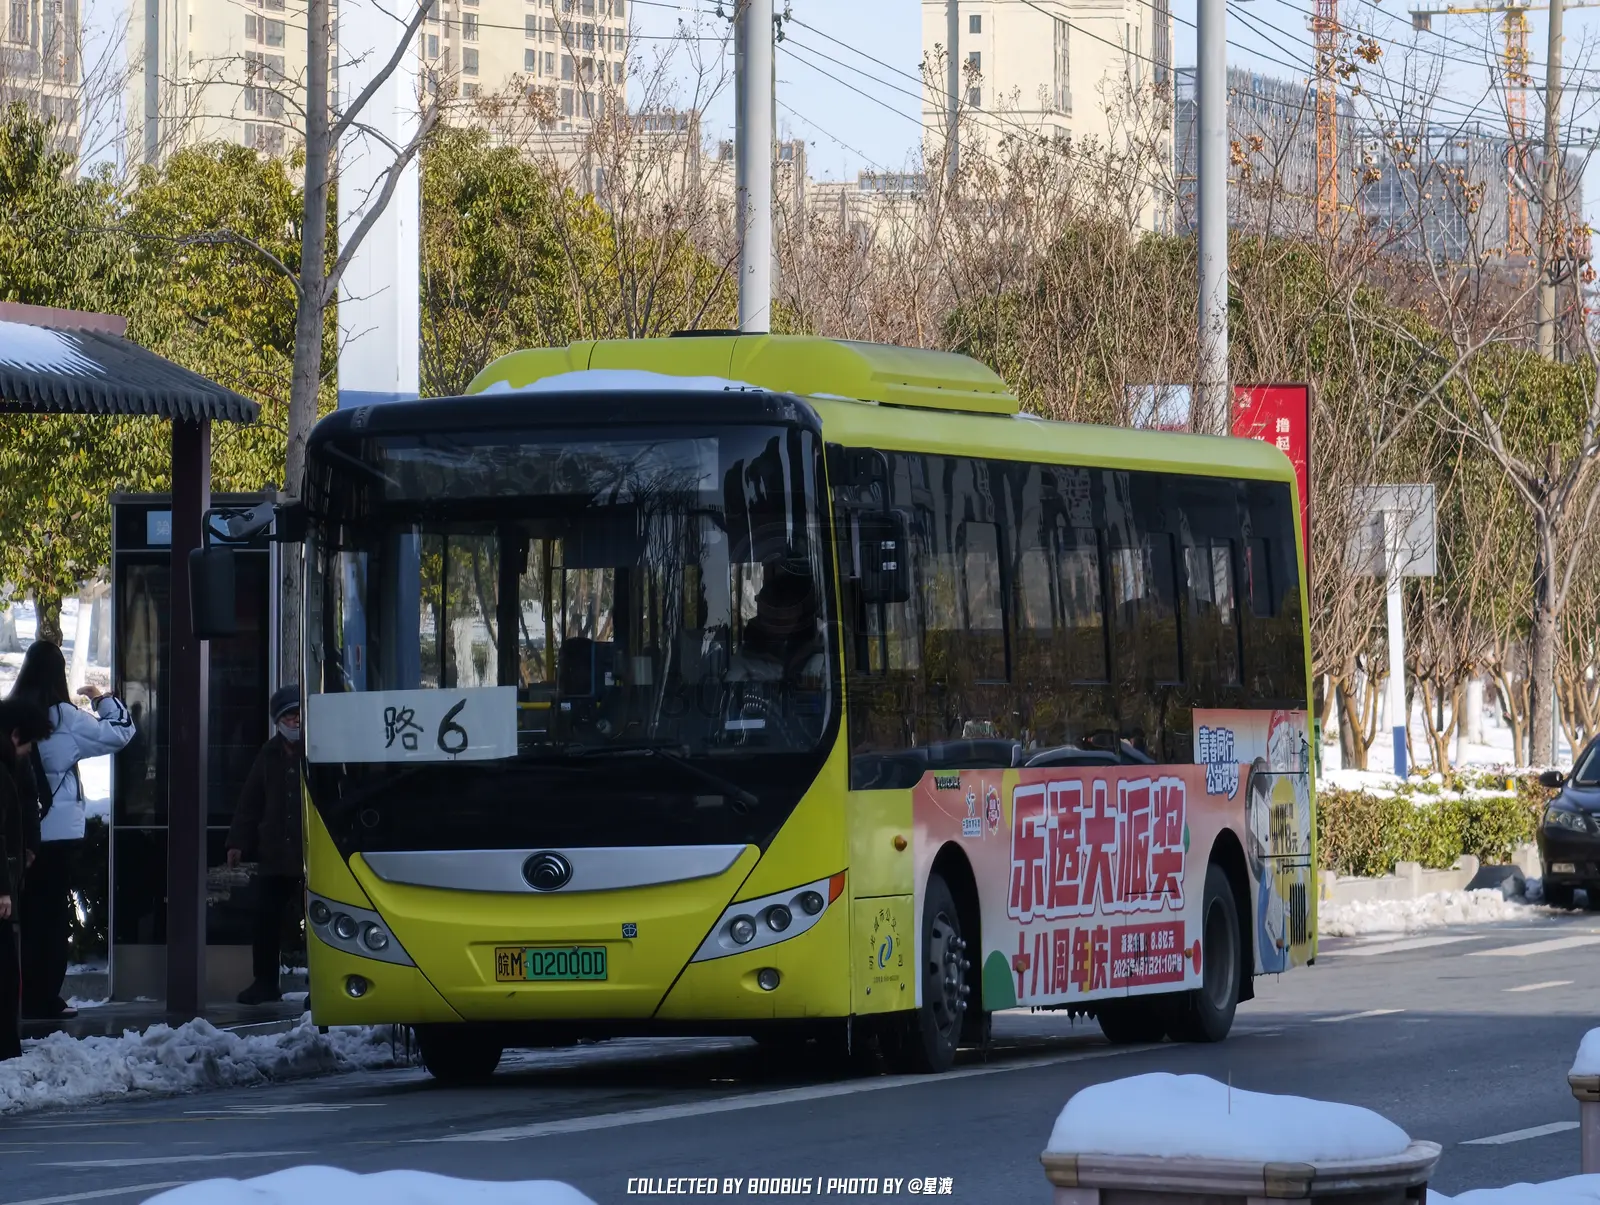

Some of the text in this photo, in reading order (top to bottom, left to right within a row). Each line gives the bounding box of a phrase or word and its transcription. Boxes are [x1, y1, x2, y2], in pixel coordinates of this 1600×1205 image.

[384, 698, 469, 755] 路 6
[1199, 725, 1235, 764] 青春同行
[1008, 777, 1187, 924] 乐透大派奖
[1012, 924, 1109, 999] 十八周年庆
